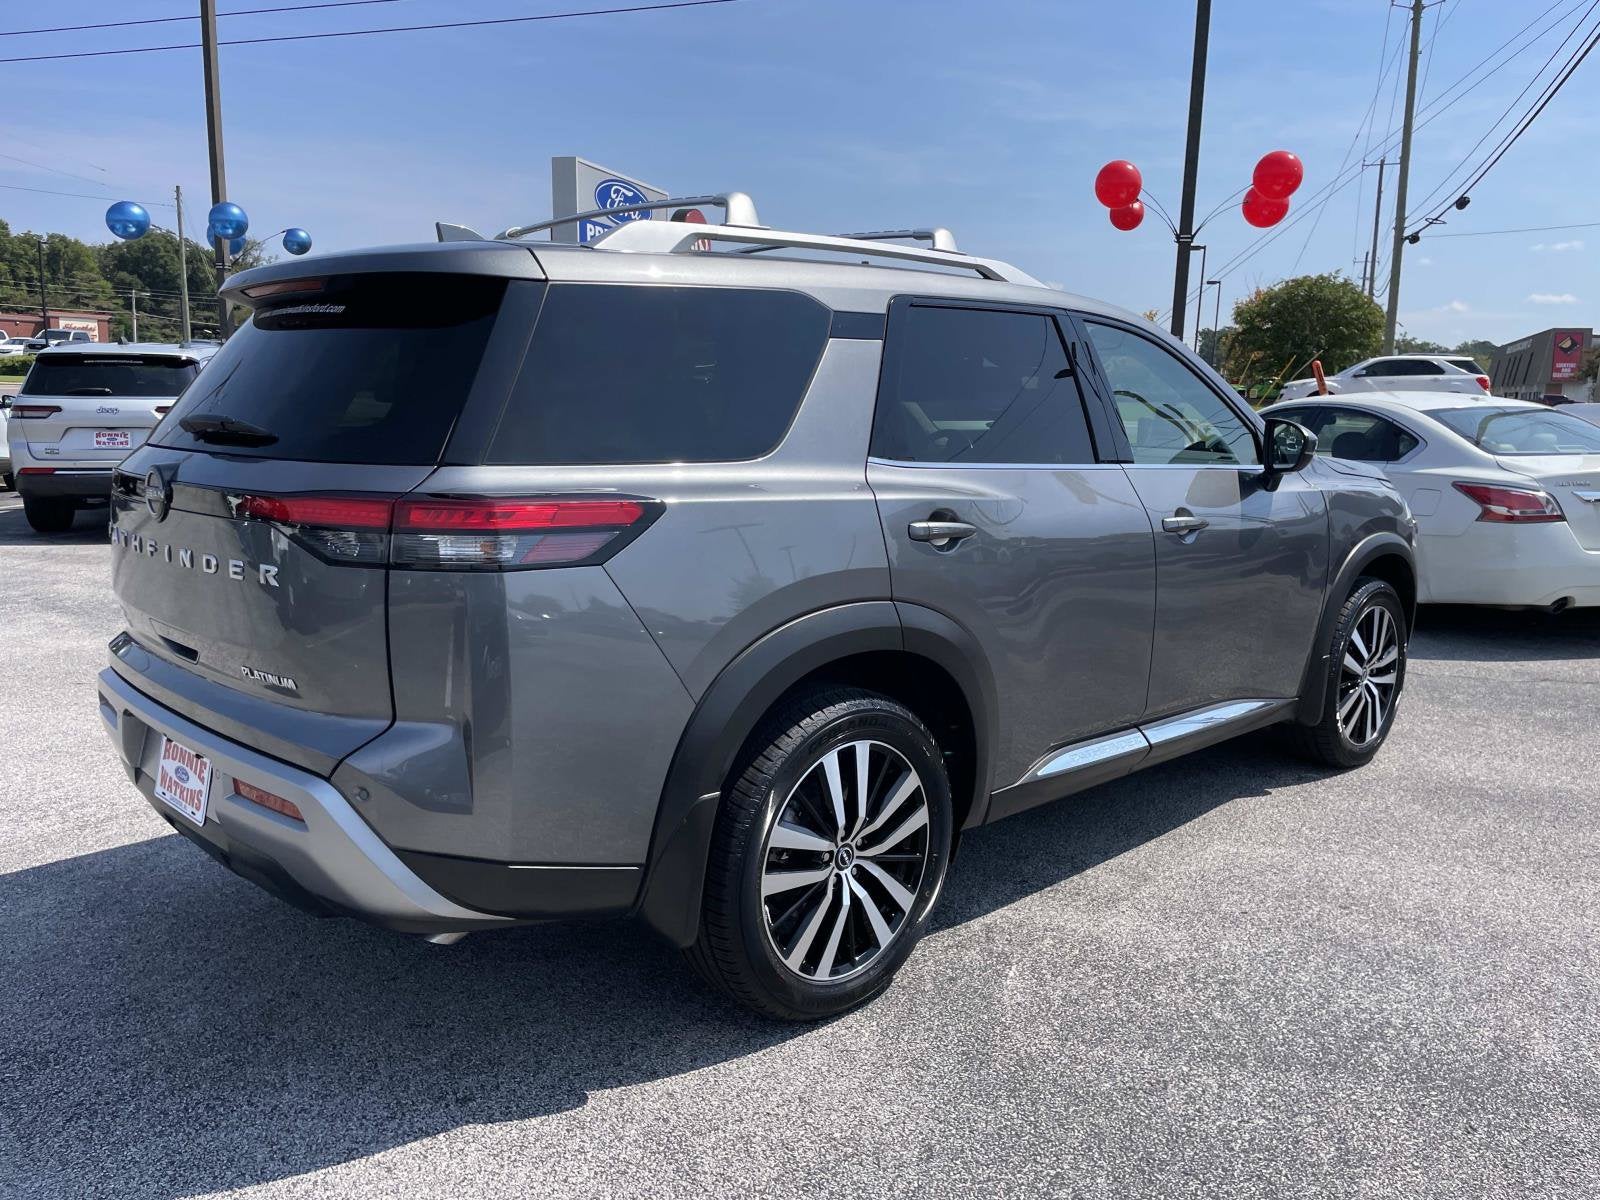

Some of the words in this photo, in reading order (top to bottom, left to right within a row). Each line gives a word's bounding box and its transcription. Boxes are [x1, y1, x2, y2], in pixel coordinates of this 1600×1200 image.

[96, 406, 119, 415] Jeep
[95, 431, 129, 439] RONNIE
[241, 665, 297, 690] PLATINUM
[163, 741, 208, 785] RONNIE
[160, 765, 203, 812] WATKINS
